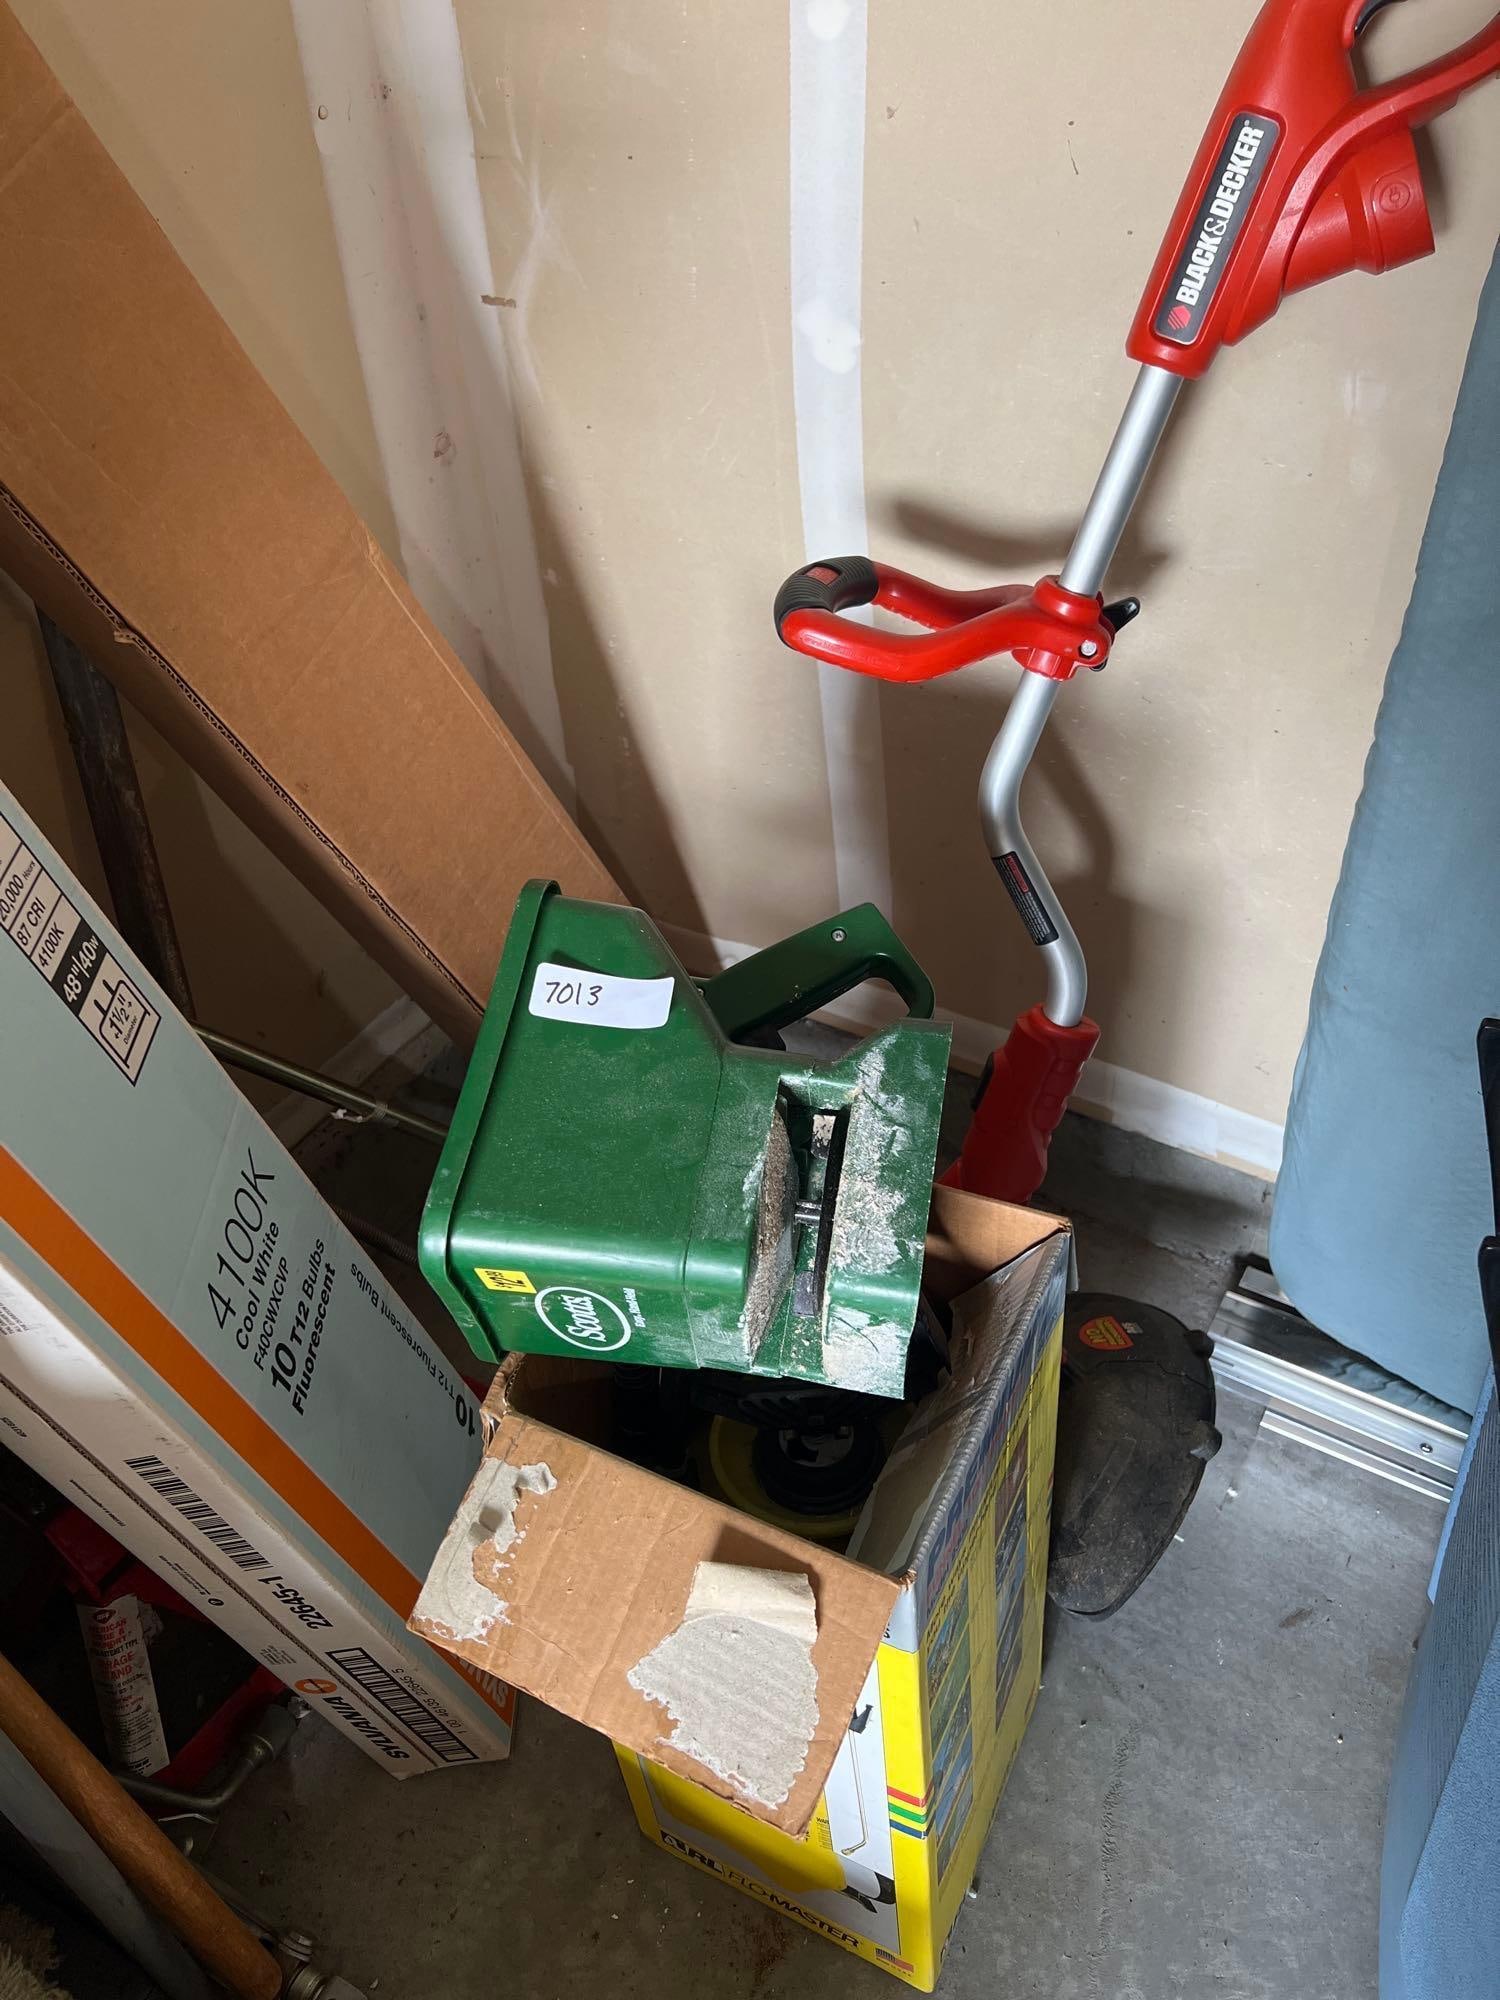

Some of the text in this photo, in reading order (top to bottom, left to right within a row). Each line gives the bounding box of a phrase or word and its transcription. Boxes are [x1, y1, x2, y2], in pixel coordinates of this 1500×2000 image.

[1176, 126, 1264, 306] BLACK&DECKER
[24, 861, 36, 881] Hours
[16, 897, 47, 947] 87 CRI
[38, 922, 65, 967] 4100K
[546, 981, 603, 1006] 7013
[123, 1015, 139, 1046] Diameter
[208, 1147, 275, 1329] 4100K
[235, 1221, 280, 1351] Cool White
[253, 1256, 290, 1372] F40CWXCVP
[271, 1238, 325, 1393] 10 T12 Bulbs
[561, 1294, 607, 1343] Scotts
[291, 1262, 336, 1416] Fluorescent
[350, 1263, 476, 1438] 10 T12 Fluorescent Bulbs
[257, 1575, 334, 1630] 22645-1
[323, 1696, 410, 1760] SYLVANIA
[729, 1871, 859, 1948] FLO-MASTER
